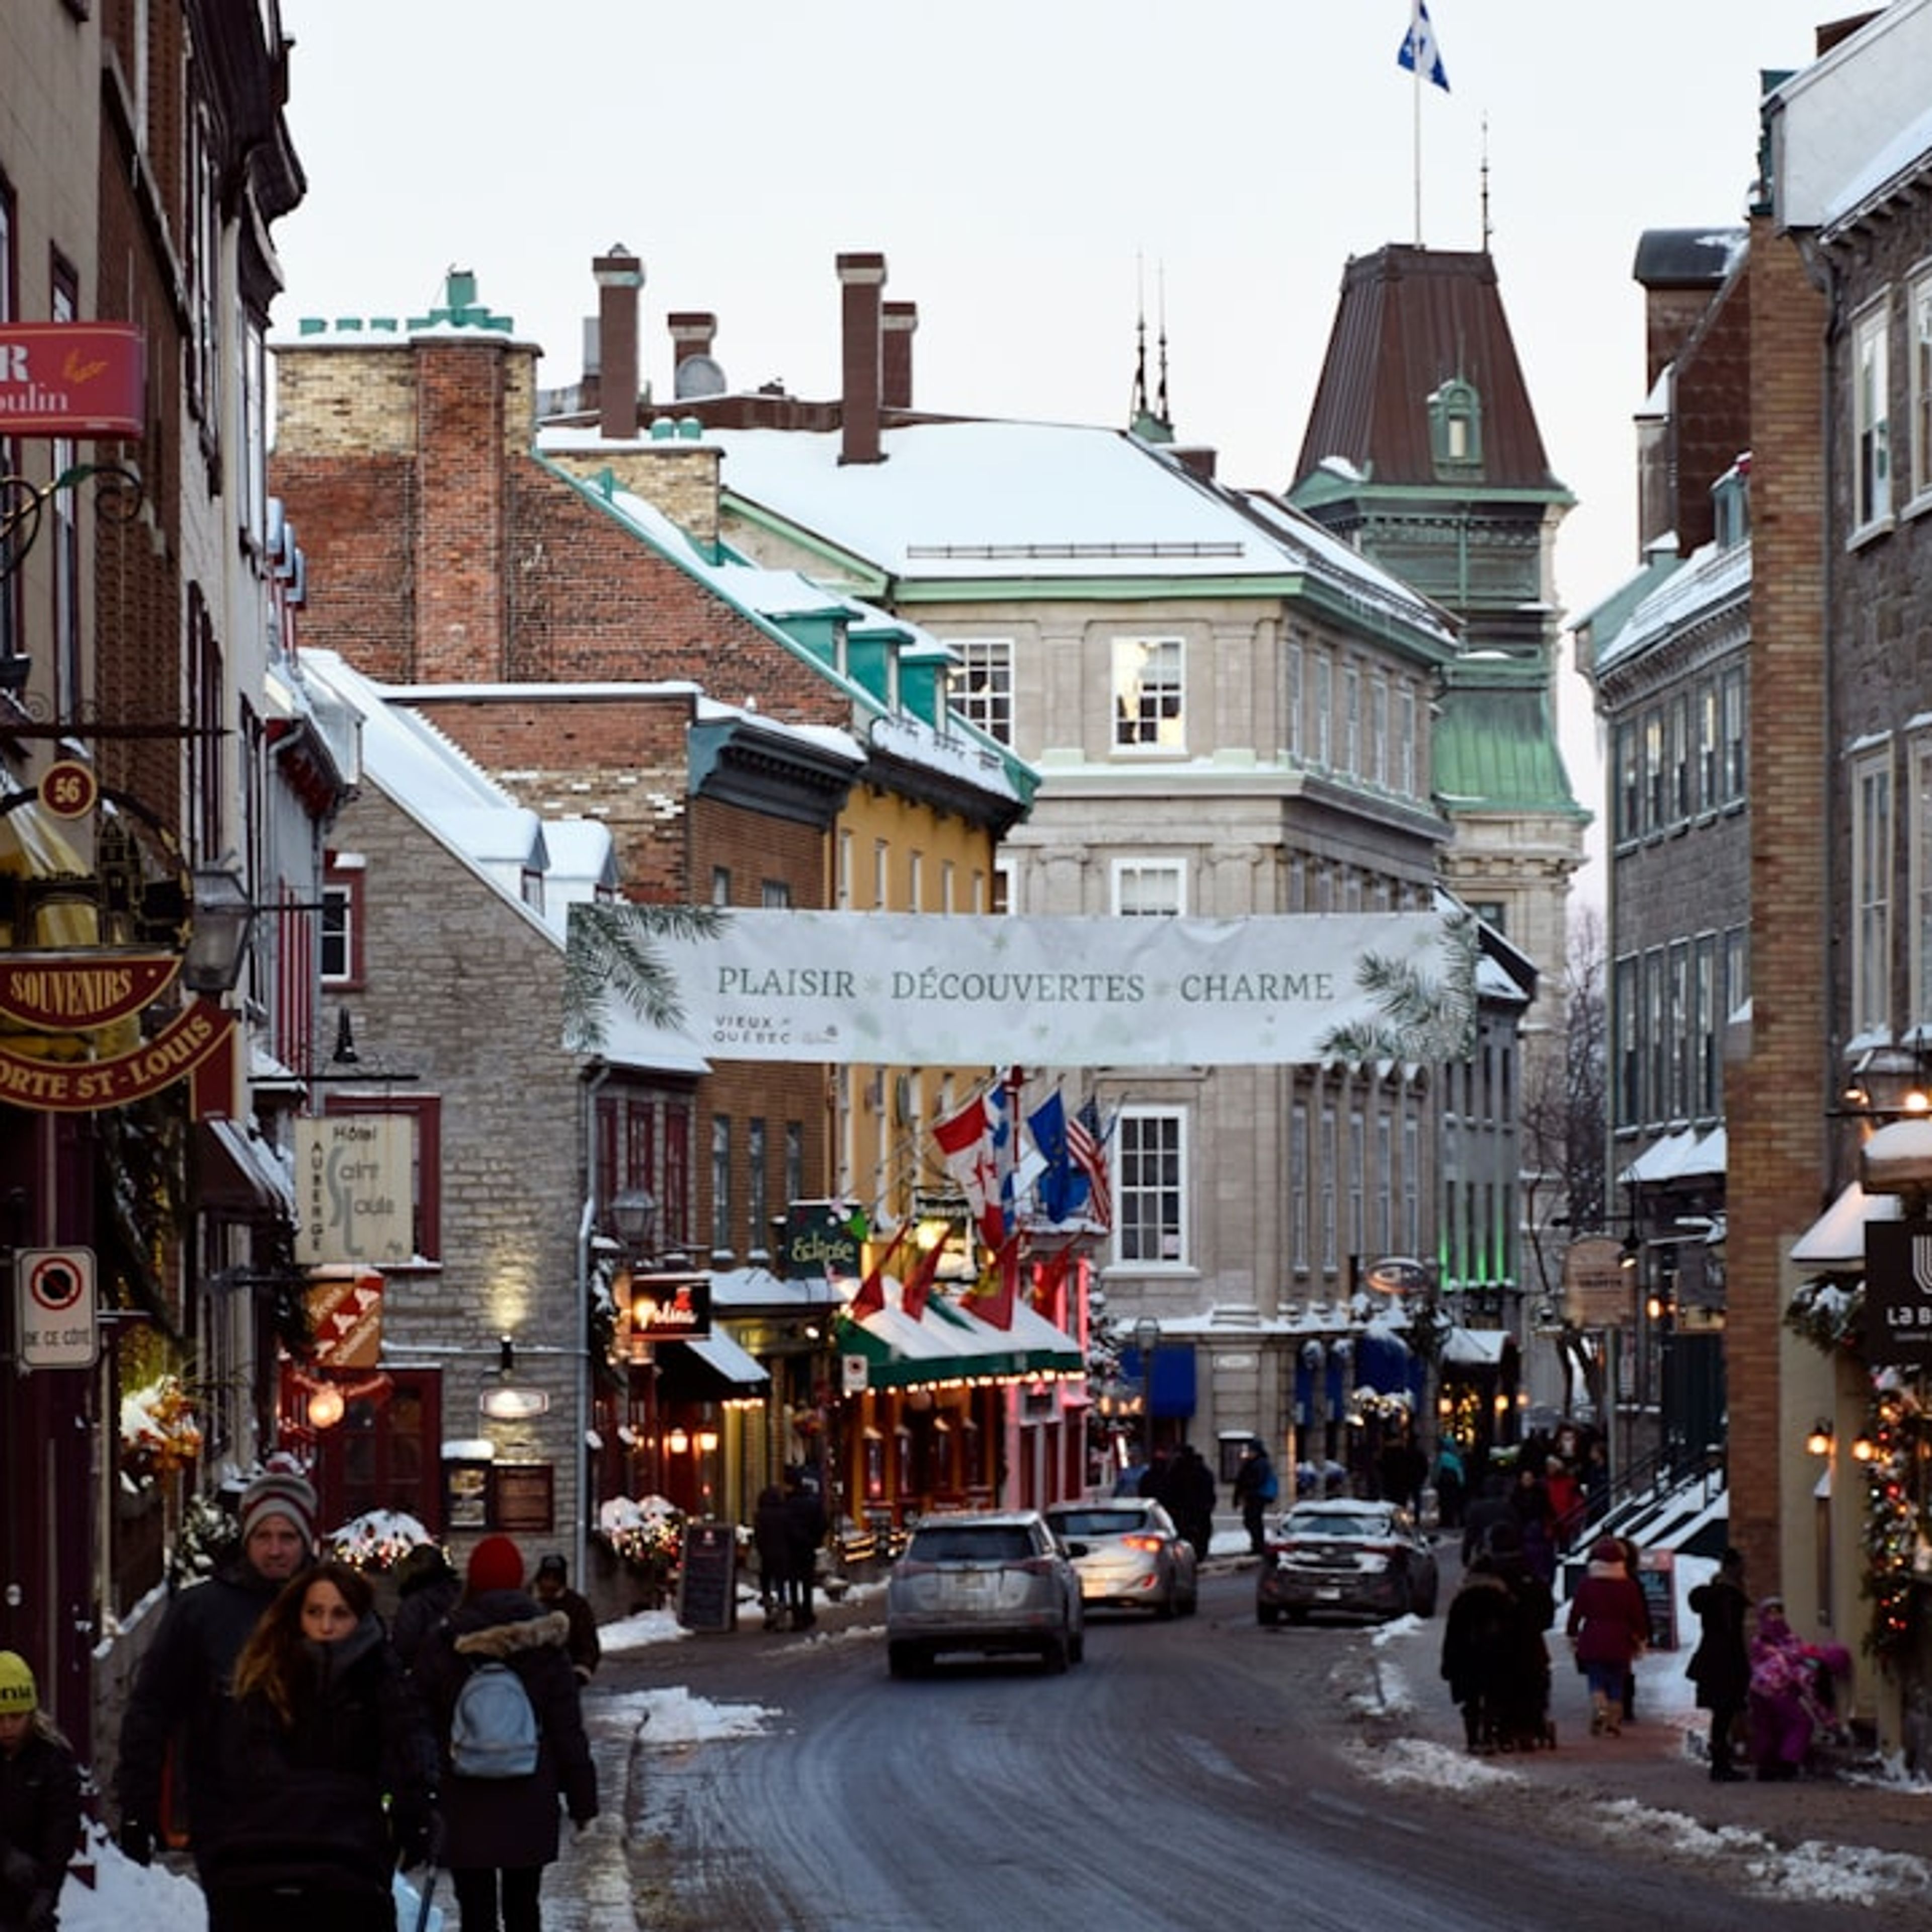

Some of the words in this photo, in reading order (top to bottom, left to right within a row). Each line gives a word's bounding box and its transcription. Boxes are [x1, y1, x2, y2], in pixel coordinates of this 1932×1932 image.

[55, 776, 80, 804] 56
[10, 968, 132, 1015] SOUVENIRS
[718, 967, 855, 998] PLAISIR
[891, 966, 1145, 1002] DÉCOUVERTES
[1180, 973, 1335, 1002] CHARME
[310, 1140, 324, 1251] AUBERGE
[44, 1330, 59, 1347] CE
